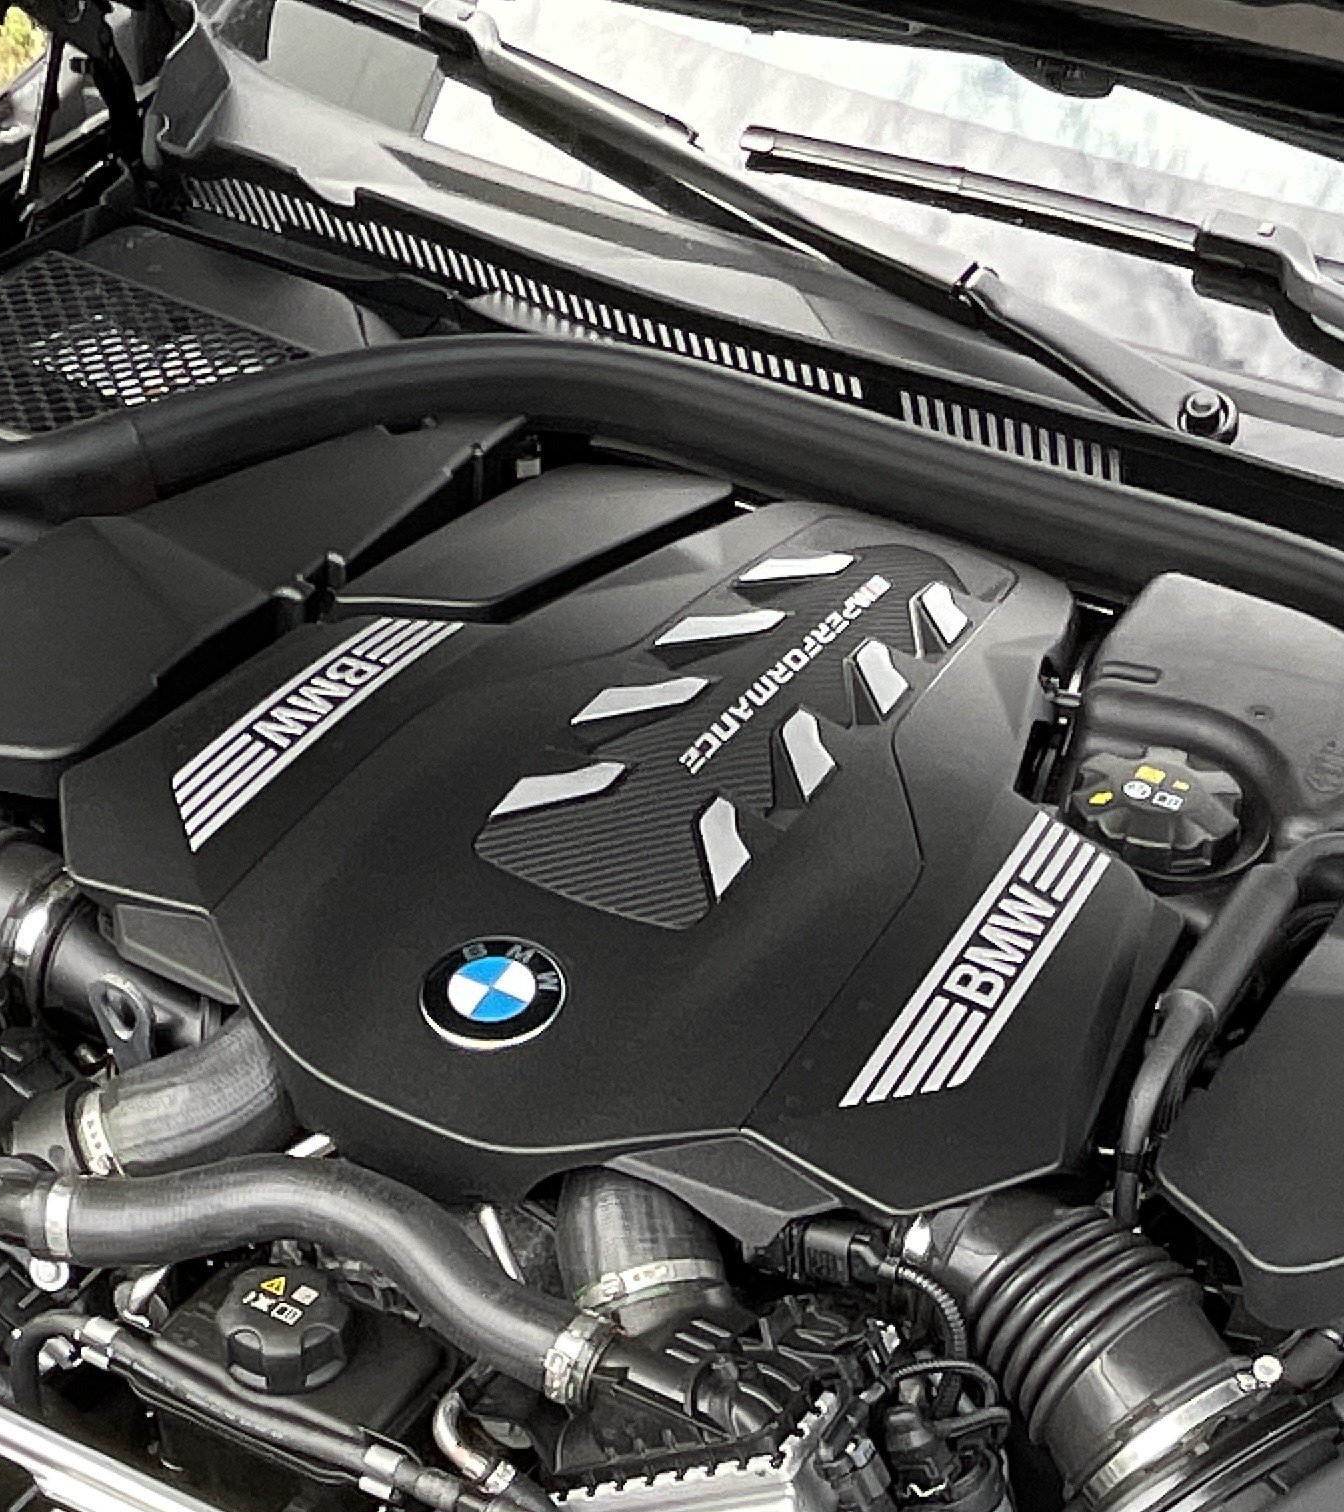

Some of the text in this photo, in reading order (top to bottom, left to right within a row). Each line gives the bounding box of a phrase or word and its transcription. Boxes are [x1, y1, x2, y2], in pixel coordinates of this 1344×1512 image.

[253, 656, 385, 749] BMW
[462, 943, 559, 991] BMW
[942, 883, 1057, 1010] BMW
